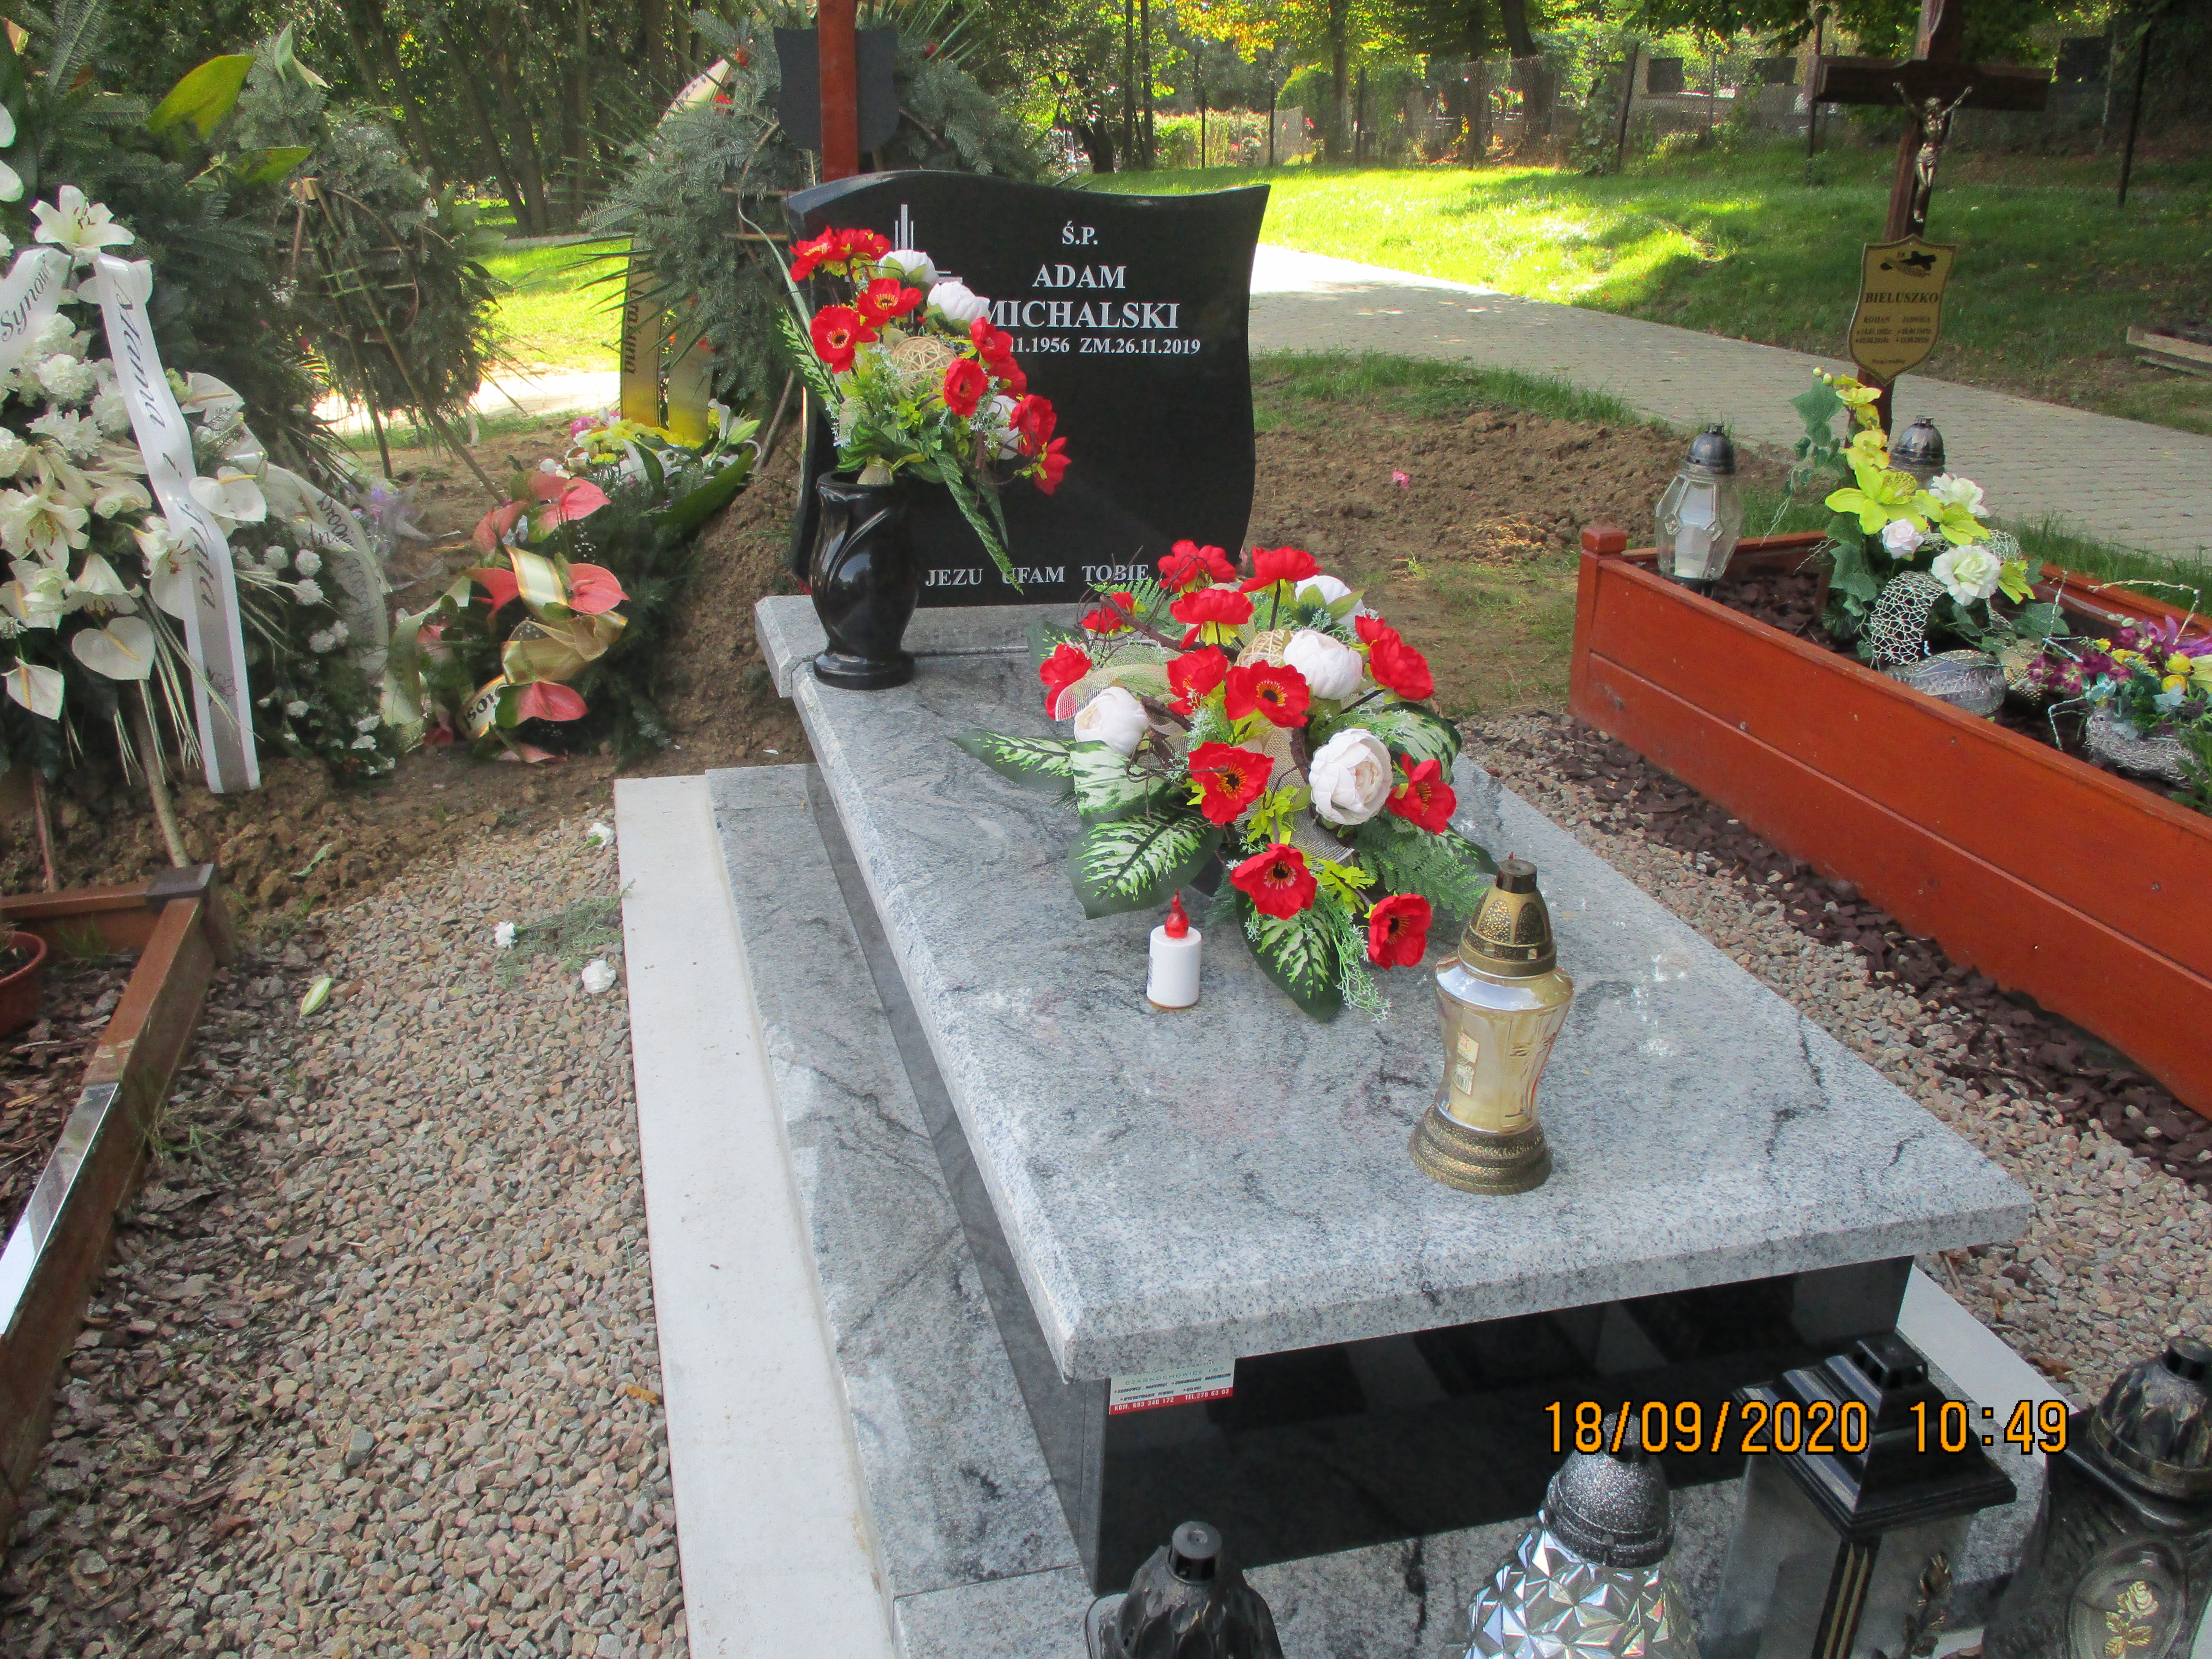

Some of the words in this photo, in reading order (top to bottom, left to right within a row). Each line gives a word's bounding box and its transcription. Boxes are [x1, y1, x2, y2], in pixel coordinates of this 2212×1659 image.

[1061, 220, 1099, 246] Ś.P.
[1031, 264, 1127, 289] ADAM
[1079, 337, 1201, 354] ZM.26.11.2019
[925, 568, 984, 587] JEZU
[1002, 566, 1066, 585] UFAM
[1081, 564, 1150, 583] TOBIE
